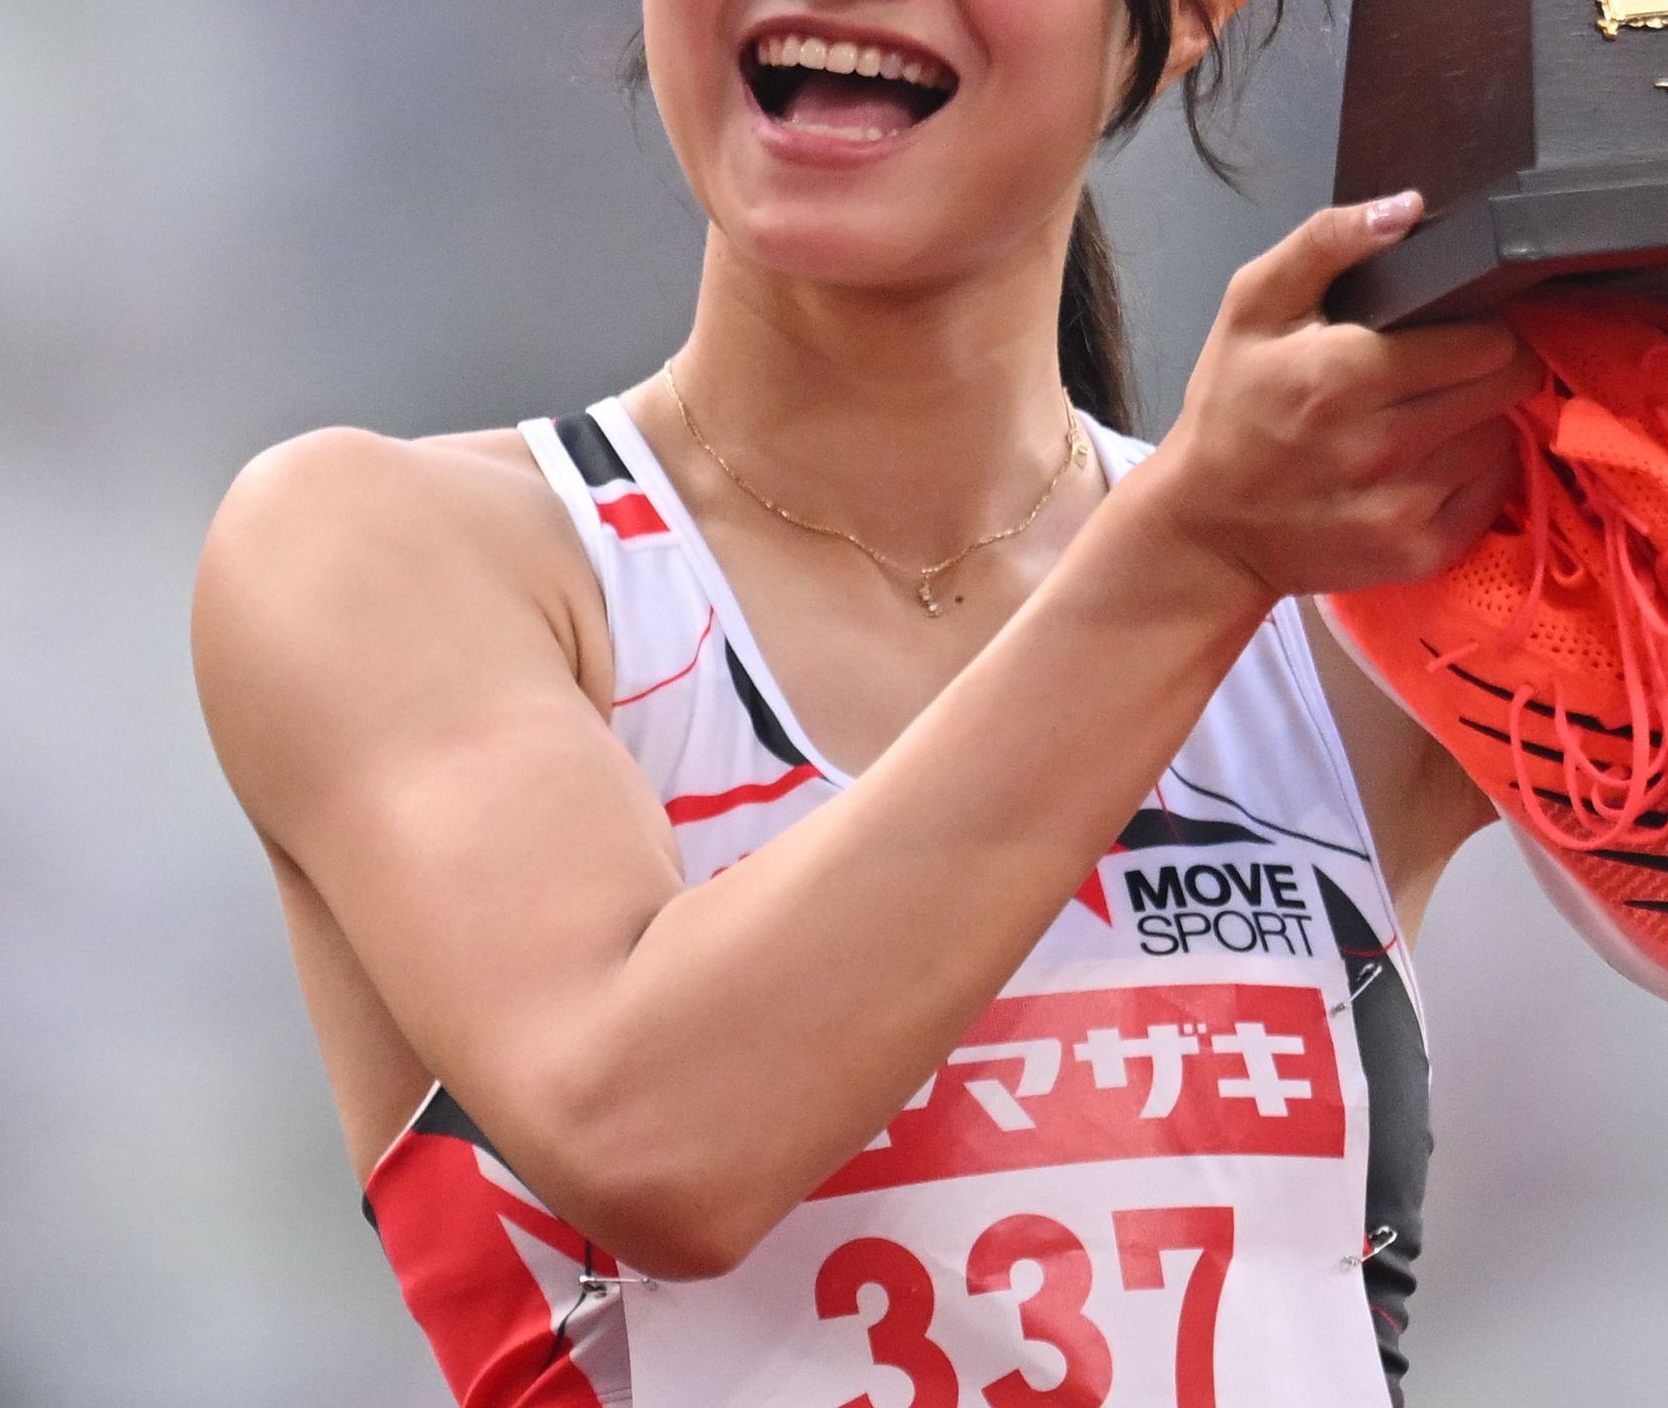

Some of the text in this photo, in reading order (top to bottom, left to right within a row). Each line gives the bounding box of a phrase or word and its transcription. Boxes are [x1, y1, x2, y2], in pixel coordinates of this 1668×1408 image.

[1124, 863, 1307, 911] MOVE
[1136, 909, 1314, 958] SPORT
[863, 1021, 1313, 1150] マザキ
[814, 1205, 1235, 1408] 337
